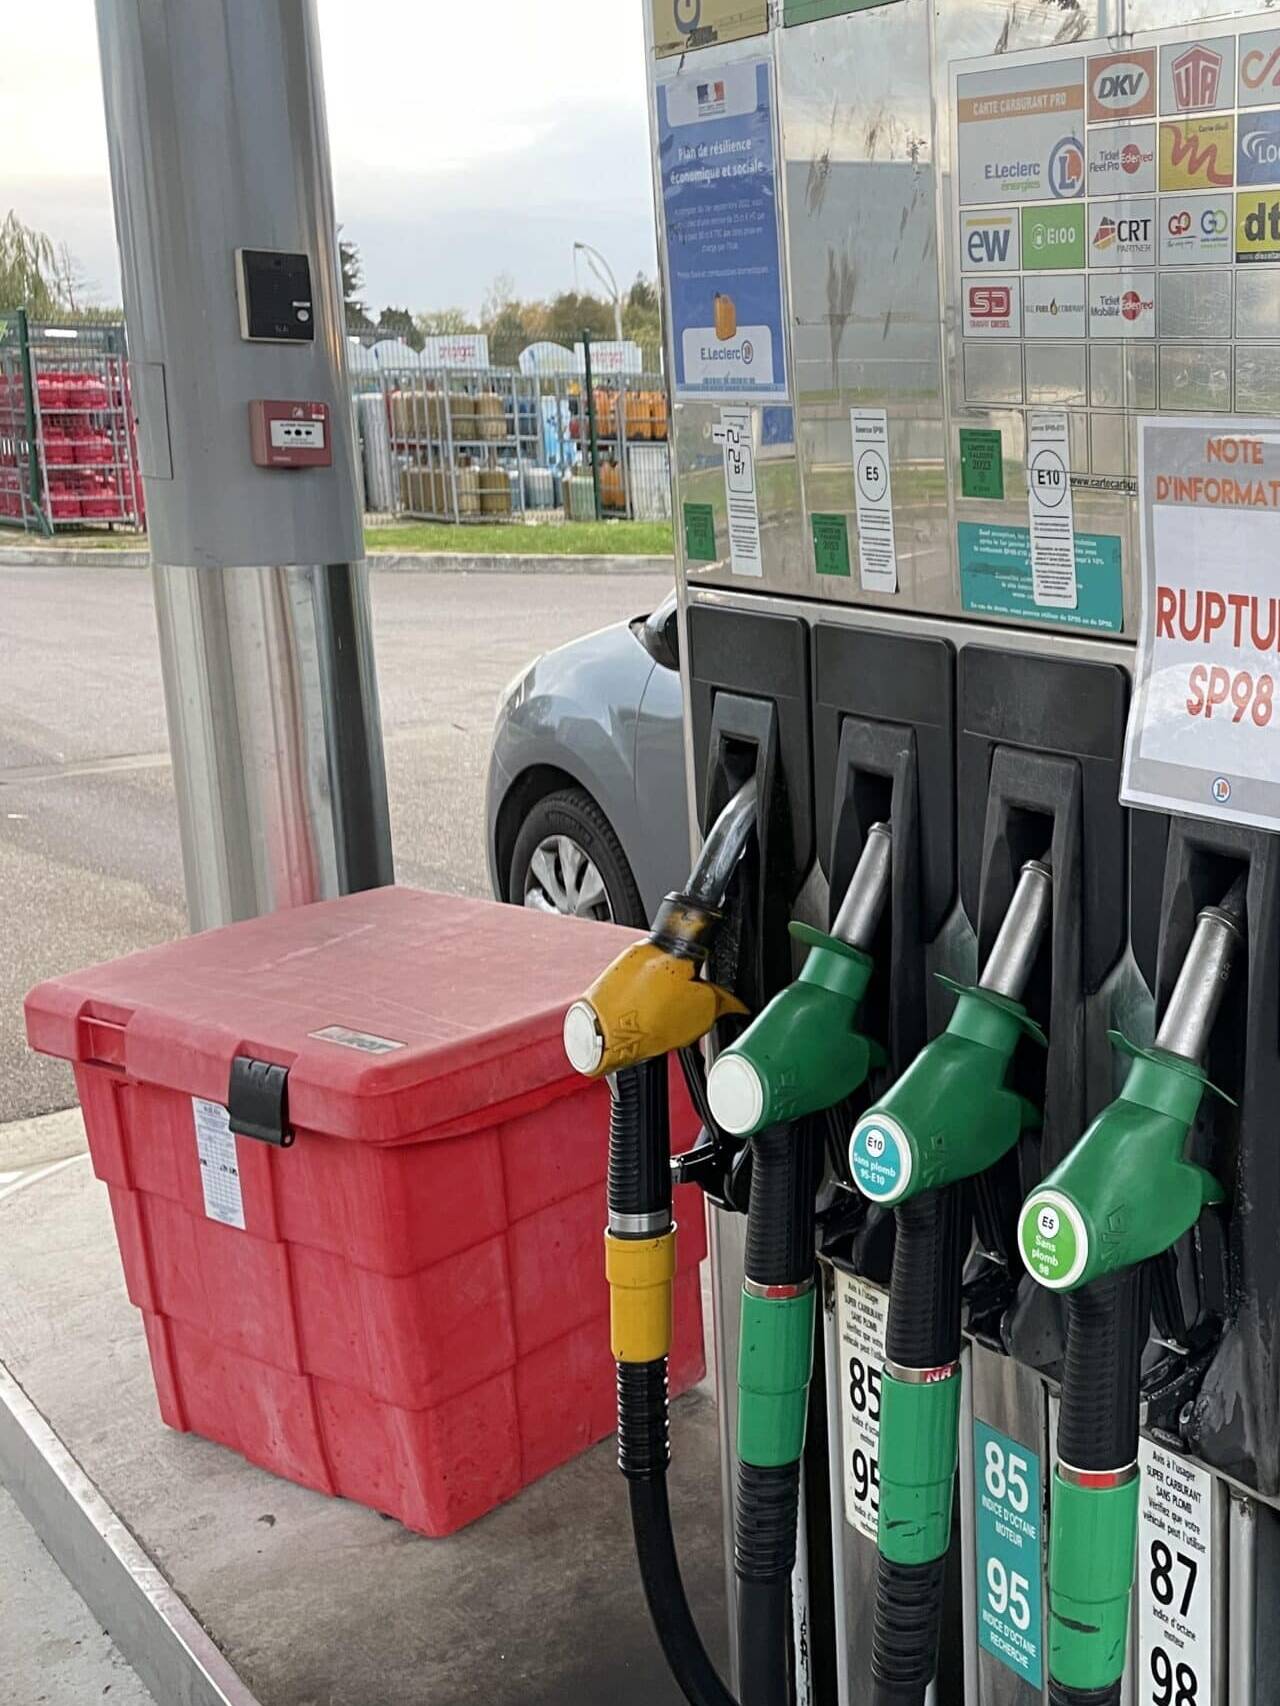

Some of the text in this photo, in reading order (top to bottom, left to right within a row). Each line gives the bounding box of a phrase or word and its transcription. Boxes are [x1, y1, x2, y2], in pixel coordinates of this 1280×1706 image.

[1098, 72, 1144, 99] DKV
[1173, 48, 1222, 108] UTA
[973, 92, 1067, 115] CARTE CARBURANT PRO
[678, 139, 752, 160] Plan de résilience
[1099, 150, 1119, 161] Ticket
[670, 158, 764, 184] économique et sociale
[984, 161, 1041, 179] E.Leclerc
[1090, 161, 1120, 173] Fleet Pro
[1117, 219, 1152, 242] CRT
[1100, 296, 1120, 306] Ticket
[700, 347, 741, 361] E.Leclerc
[1207, 438, 1264, 465] NOTE
[866, 466, 879, 481] E5
[1037, 469, 1060, 485] E10
[1186, 664, 1275, 727] SP98
[867, 1136, 883, 1150] E10
[854, 1152, 896, 1178] Sans plomb
[860, 1169, 885, 1186] 95-E10
[1042, 1216, 1054, 1230] E5
[1035, 1234, 1056, 1252] Sans
[1032, 1249, 1059, 1267] plomb
[1039, 1263, 1050, 1276] 98
[849, 1357, 882, 1422] 85
[985, 1441, 1029, 1513] 85
[1152, 1450, 1165, 1465] Avis
[1172, 1459, 1195, 1481] l'usager
[852, 1448, 880, 1512] 95
[1147, 1464, 1202, 1503] SUPER CARBURANT
[1156, 1485, 1192, 1514] SANS PLOMB
[982, 1494, 1037, 1540] INDICE D'OCTANE
[1143, 1511, 1166, 1531] véhicule
[1167, 1525, 1181, 1539] peut
[1171, 1512, 1182, 1525] que
[1184, 1519, 1200, 1535] votre
[995, 1520, 1023, 1548] MOTEUR
[1150, 1540, 1198, 1617] 87
[987, 1557, 1031, 1630] 95
[982, 1608, 1037, 1658] INDICE D'OCTANE
[990, 1631, 1029, 1669] RECHERCHE
[1151, 1646, 1198, 1706] 98
